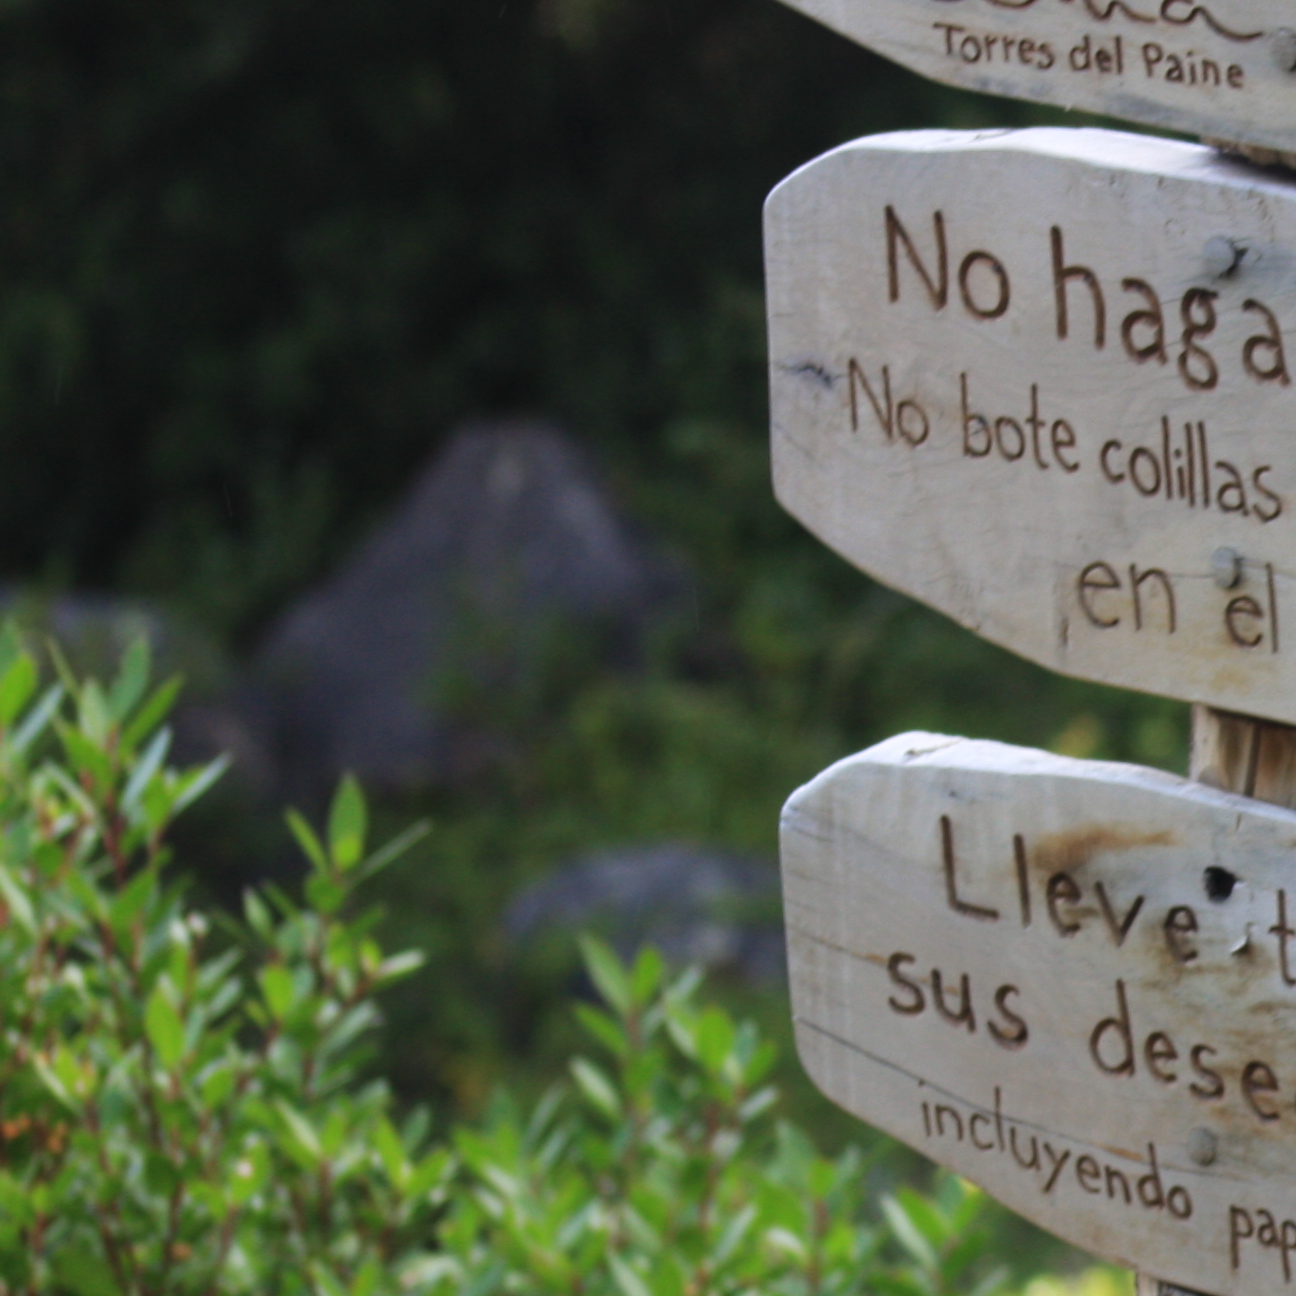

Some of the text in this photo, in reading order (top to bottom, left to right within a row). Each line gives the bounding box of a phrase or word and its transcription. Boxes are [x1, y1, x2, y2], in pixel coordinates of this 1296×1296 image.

[932, 22, 1245, 88] Torres del Paine
[884, 205, 1011, 319] No
[1052, 225, 1291, 391] haga
[846, 358, 931, 447] No
[960, 372, 1080, 474] bote
[1101, 415, 1284, 523] colillas
[1076, 559, 1177, 634] en
[1224, 562, 1280, 654] el
[939, 813, 1199, 964] Lleve
[886, 952, 1031, 1049] sus
[918, 1080, 1193, 1221] incluyendo
